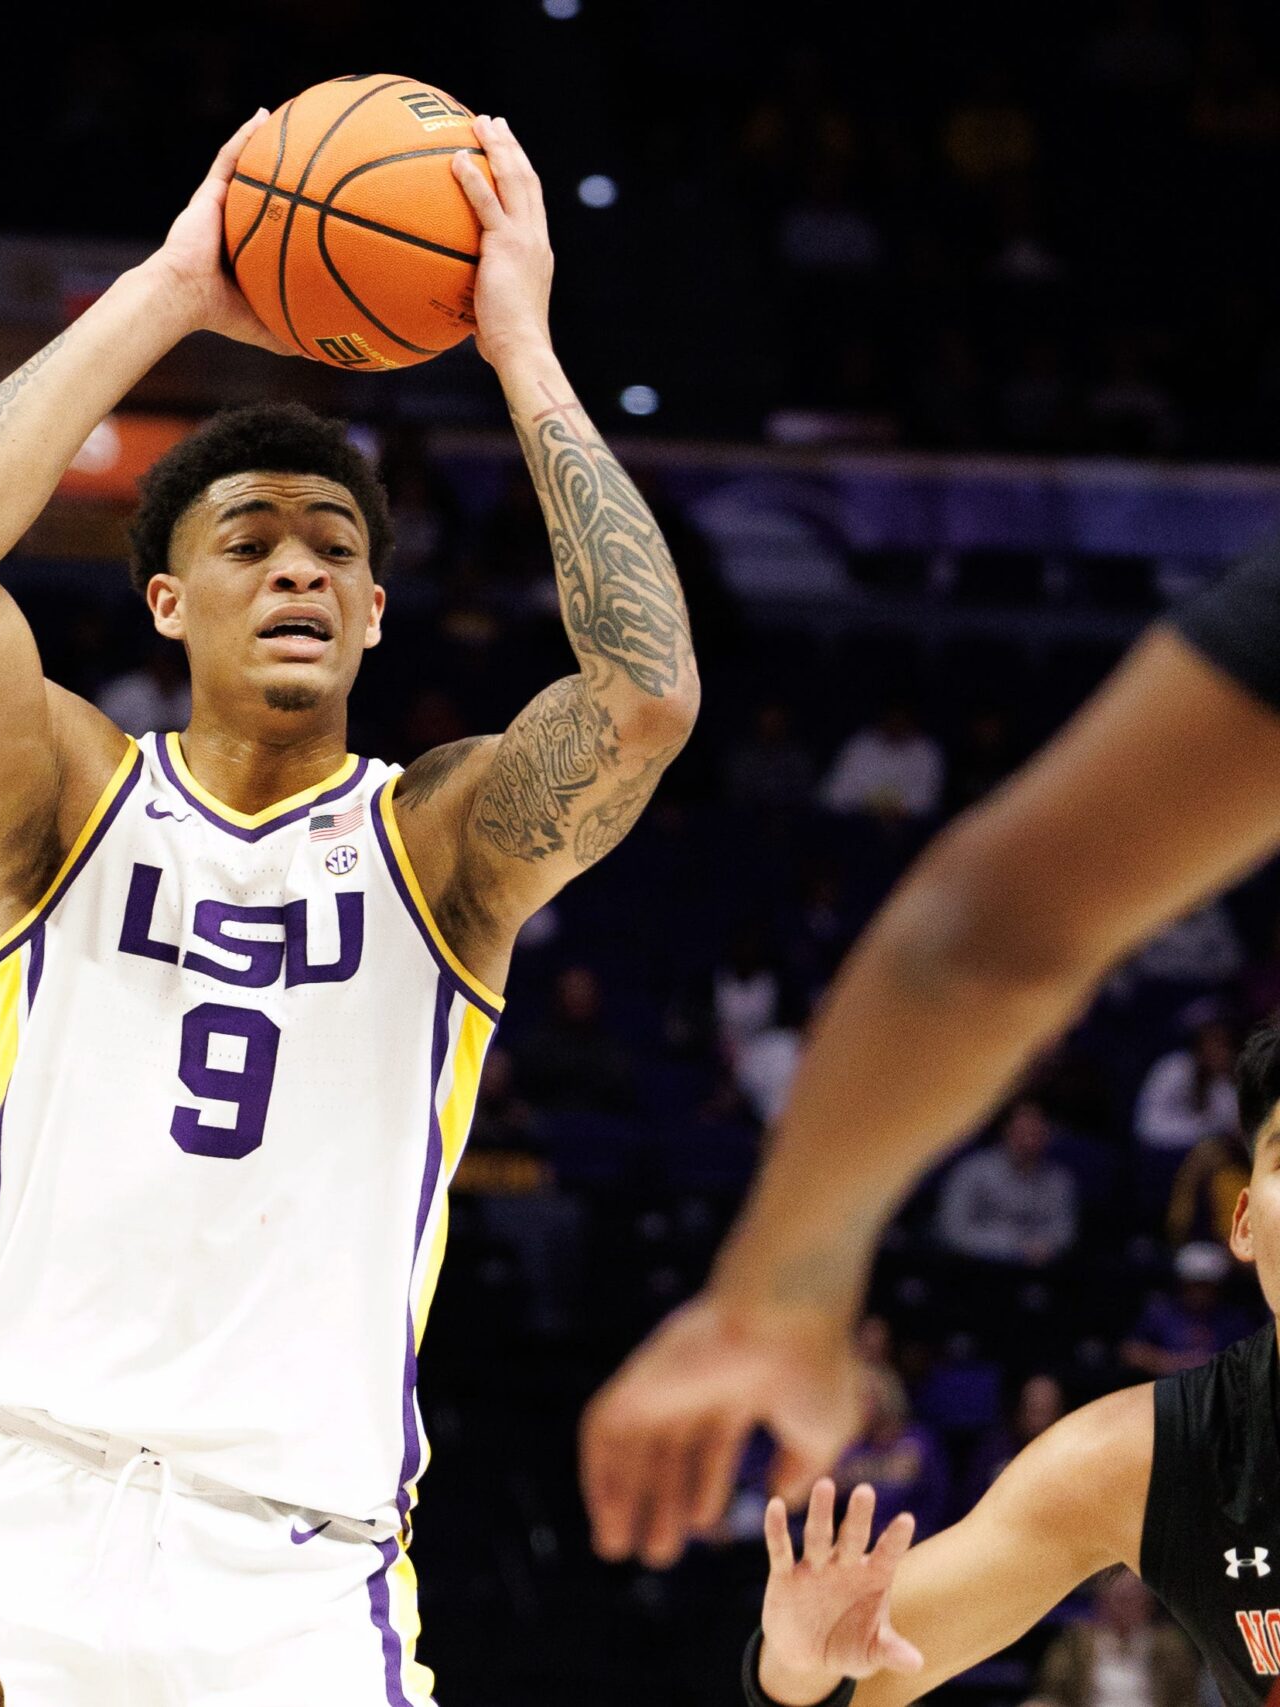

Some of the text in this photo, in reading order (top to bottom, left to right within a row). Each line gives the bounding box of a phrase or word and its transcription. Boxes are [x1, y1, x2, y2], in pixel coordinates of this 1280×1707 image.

[325, 844, 358, 876] SEC
[118, 862, 365, 990] LSU
[170, 1002, 281, 1160] 9
